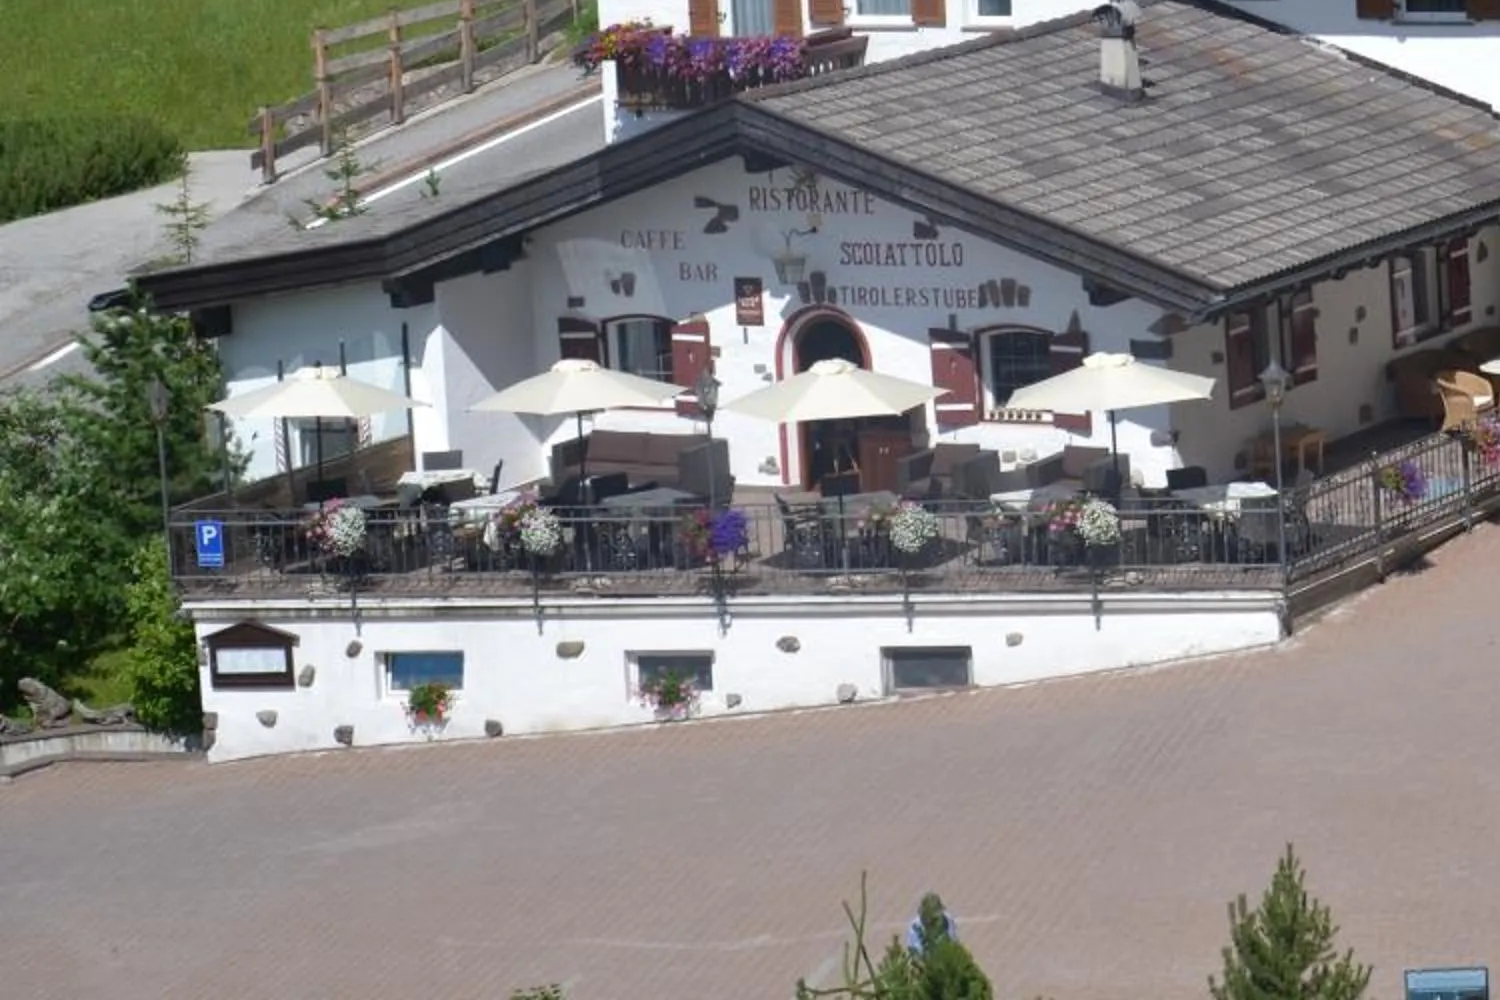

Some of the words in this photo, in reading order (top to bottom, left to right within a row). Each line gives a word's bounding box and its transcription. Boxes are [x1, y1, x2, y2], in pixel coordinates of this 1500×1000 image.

[748, 185, 876, 215] RISTORANTE
[839, 241, 964, 267] SCOIATTOLO
[679, 262, 718, 282] BAR
[839, 286, 978, 309] TIROLERSTUBE
[202, 525, 217, 546] P
